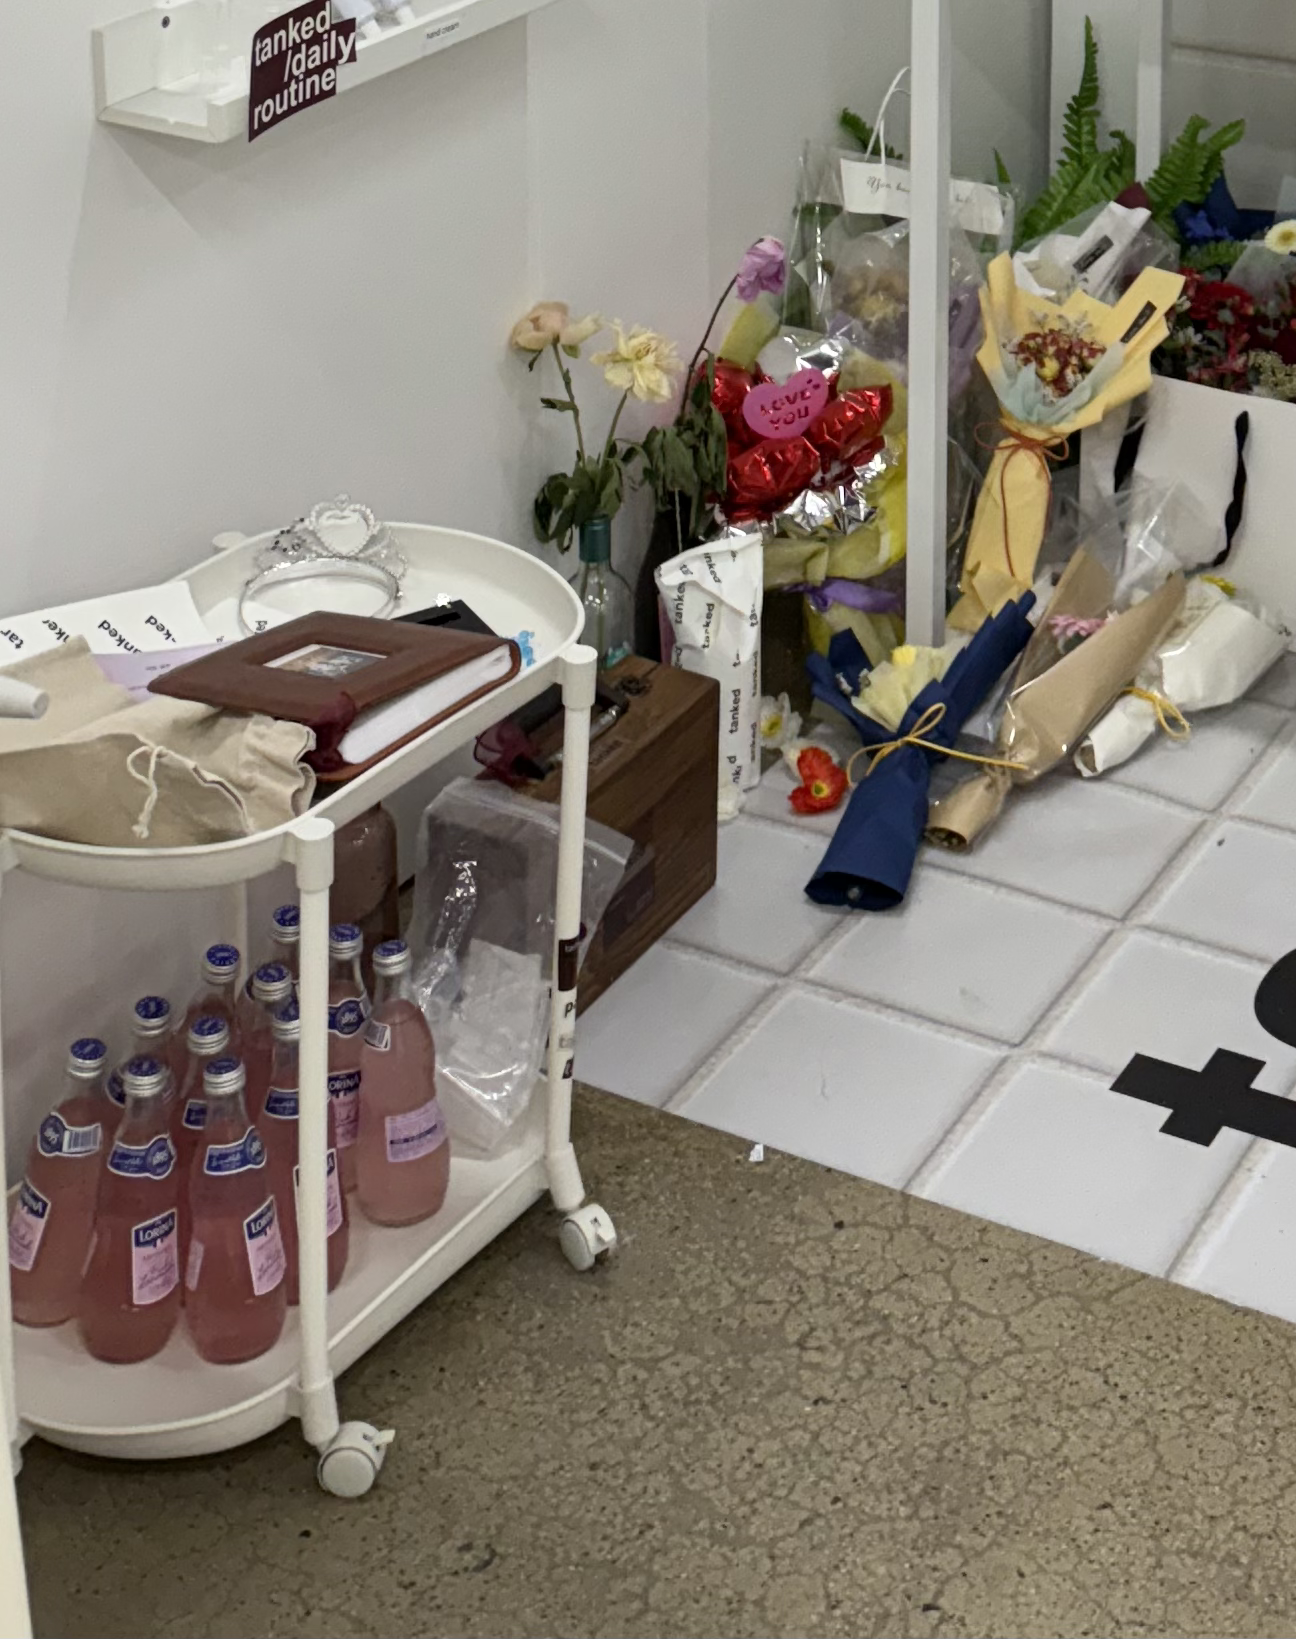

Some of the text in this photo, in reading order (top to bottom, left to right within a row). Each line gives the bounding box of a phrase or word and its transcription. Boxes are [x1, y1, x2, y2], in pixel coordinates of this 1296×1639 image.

[254, 0, 332, 68] tanked
[284, 29, 357, 82] /daily
[426, 29, 441, 40] hand
[253, 62, 337, 130] routine
[729, 688, 742, 734] tanked
[329, 1074, 360, 1090] ORINA
[139, 1217, 174, 1243] LORINA
